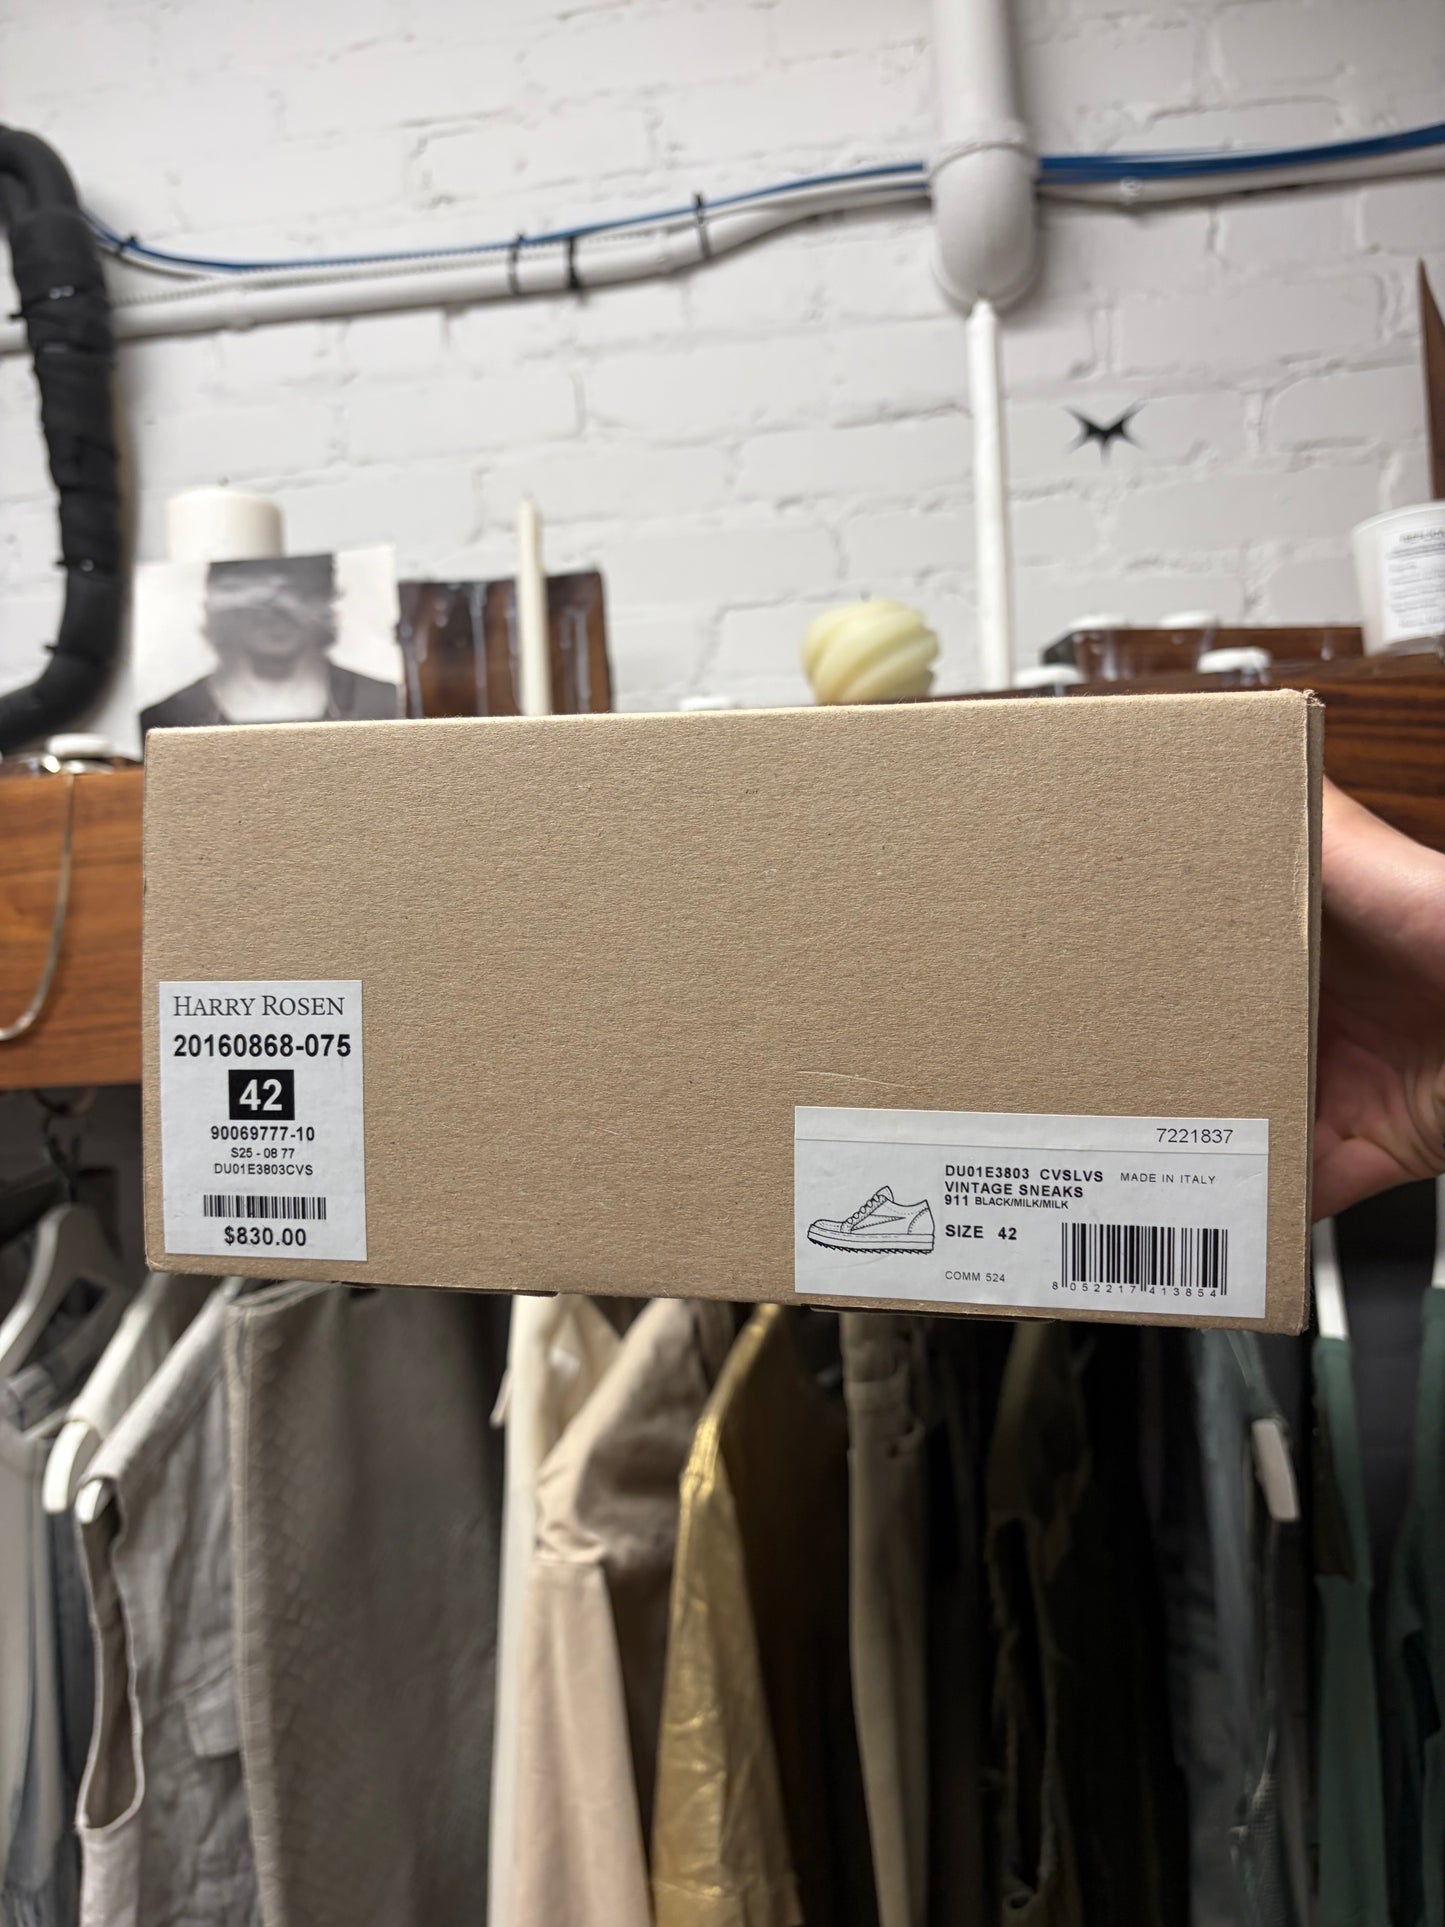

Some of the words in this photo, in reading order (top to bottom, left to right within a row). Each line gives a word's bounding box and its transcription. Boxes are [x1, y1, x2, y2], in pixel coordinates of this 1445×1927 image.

[173, 996, 255, 1016] HARRY
[261, 995, 345, 1016] ROSEN
[173, 1033, 352, 1057] 20160868-075
[239, 1079, 283, 1111] 42
[210, 1125, 315, 1142] 90069777-10
[1156, 1127, 1233, 1144] 7221837
[231, 1147, 253, 1158] S25
[263, 1147, 278, 1159] 08
[281, 1147, 295, 1159] 77
[214, 1163, 313, 1176] DU01E3803CVS
[945, 1164, 1030, 1180] DU01E3803
[1039, 1168, 1104, 1183] CVSLVS
[1120, 1172, 1157, 1183] MADE
[1161, 1174, 1174, 1184] IN
[1180, 1174, 1216, 1185] ITALY
[944, 1181, 1013, 1195] VINTAGE
[1018, 1184, 1084, 1198] SNEAKS
[944, 1194, 968, 1206] 911
[975, 1196, 1069, 1209] BLACK/MILK/MILK
[224, 1225, 307, 1246] $830.00
[945, 1224, 984, 1239] SIZE
[998, 1227, 1018, 1240] 42
[945, 1270, 981, 1281] COMM
[985, 1273, 1006, 1282] 524
